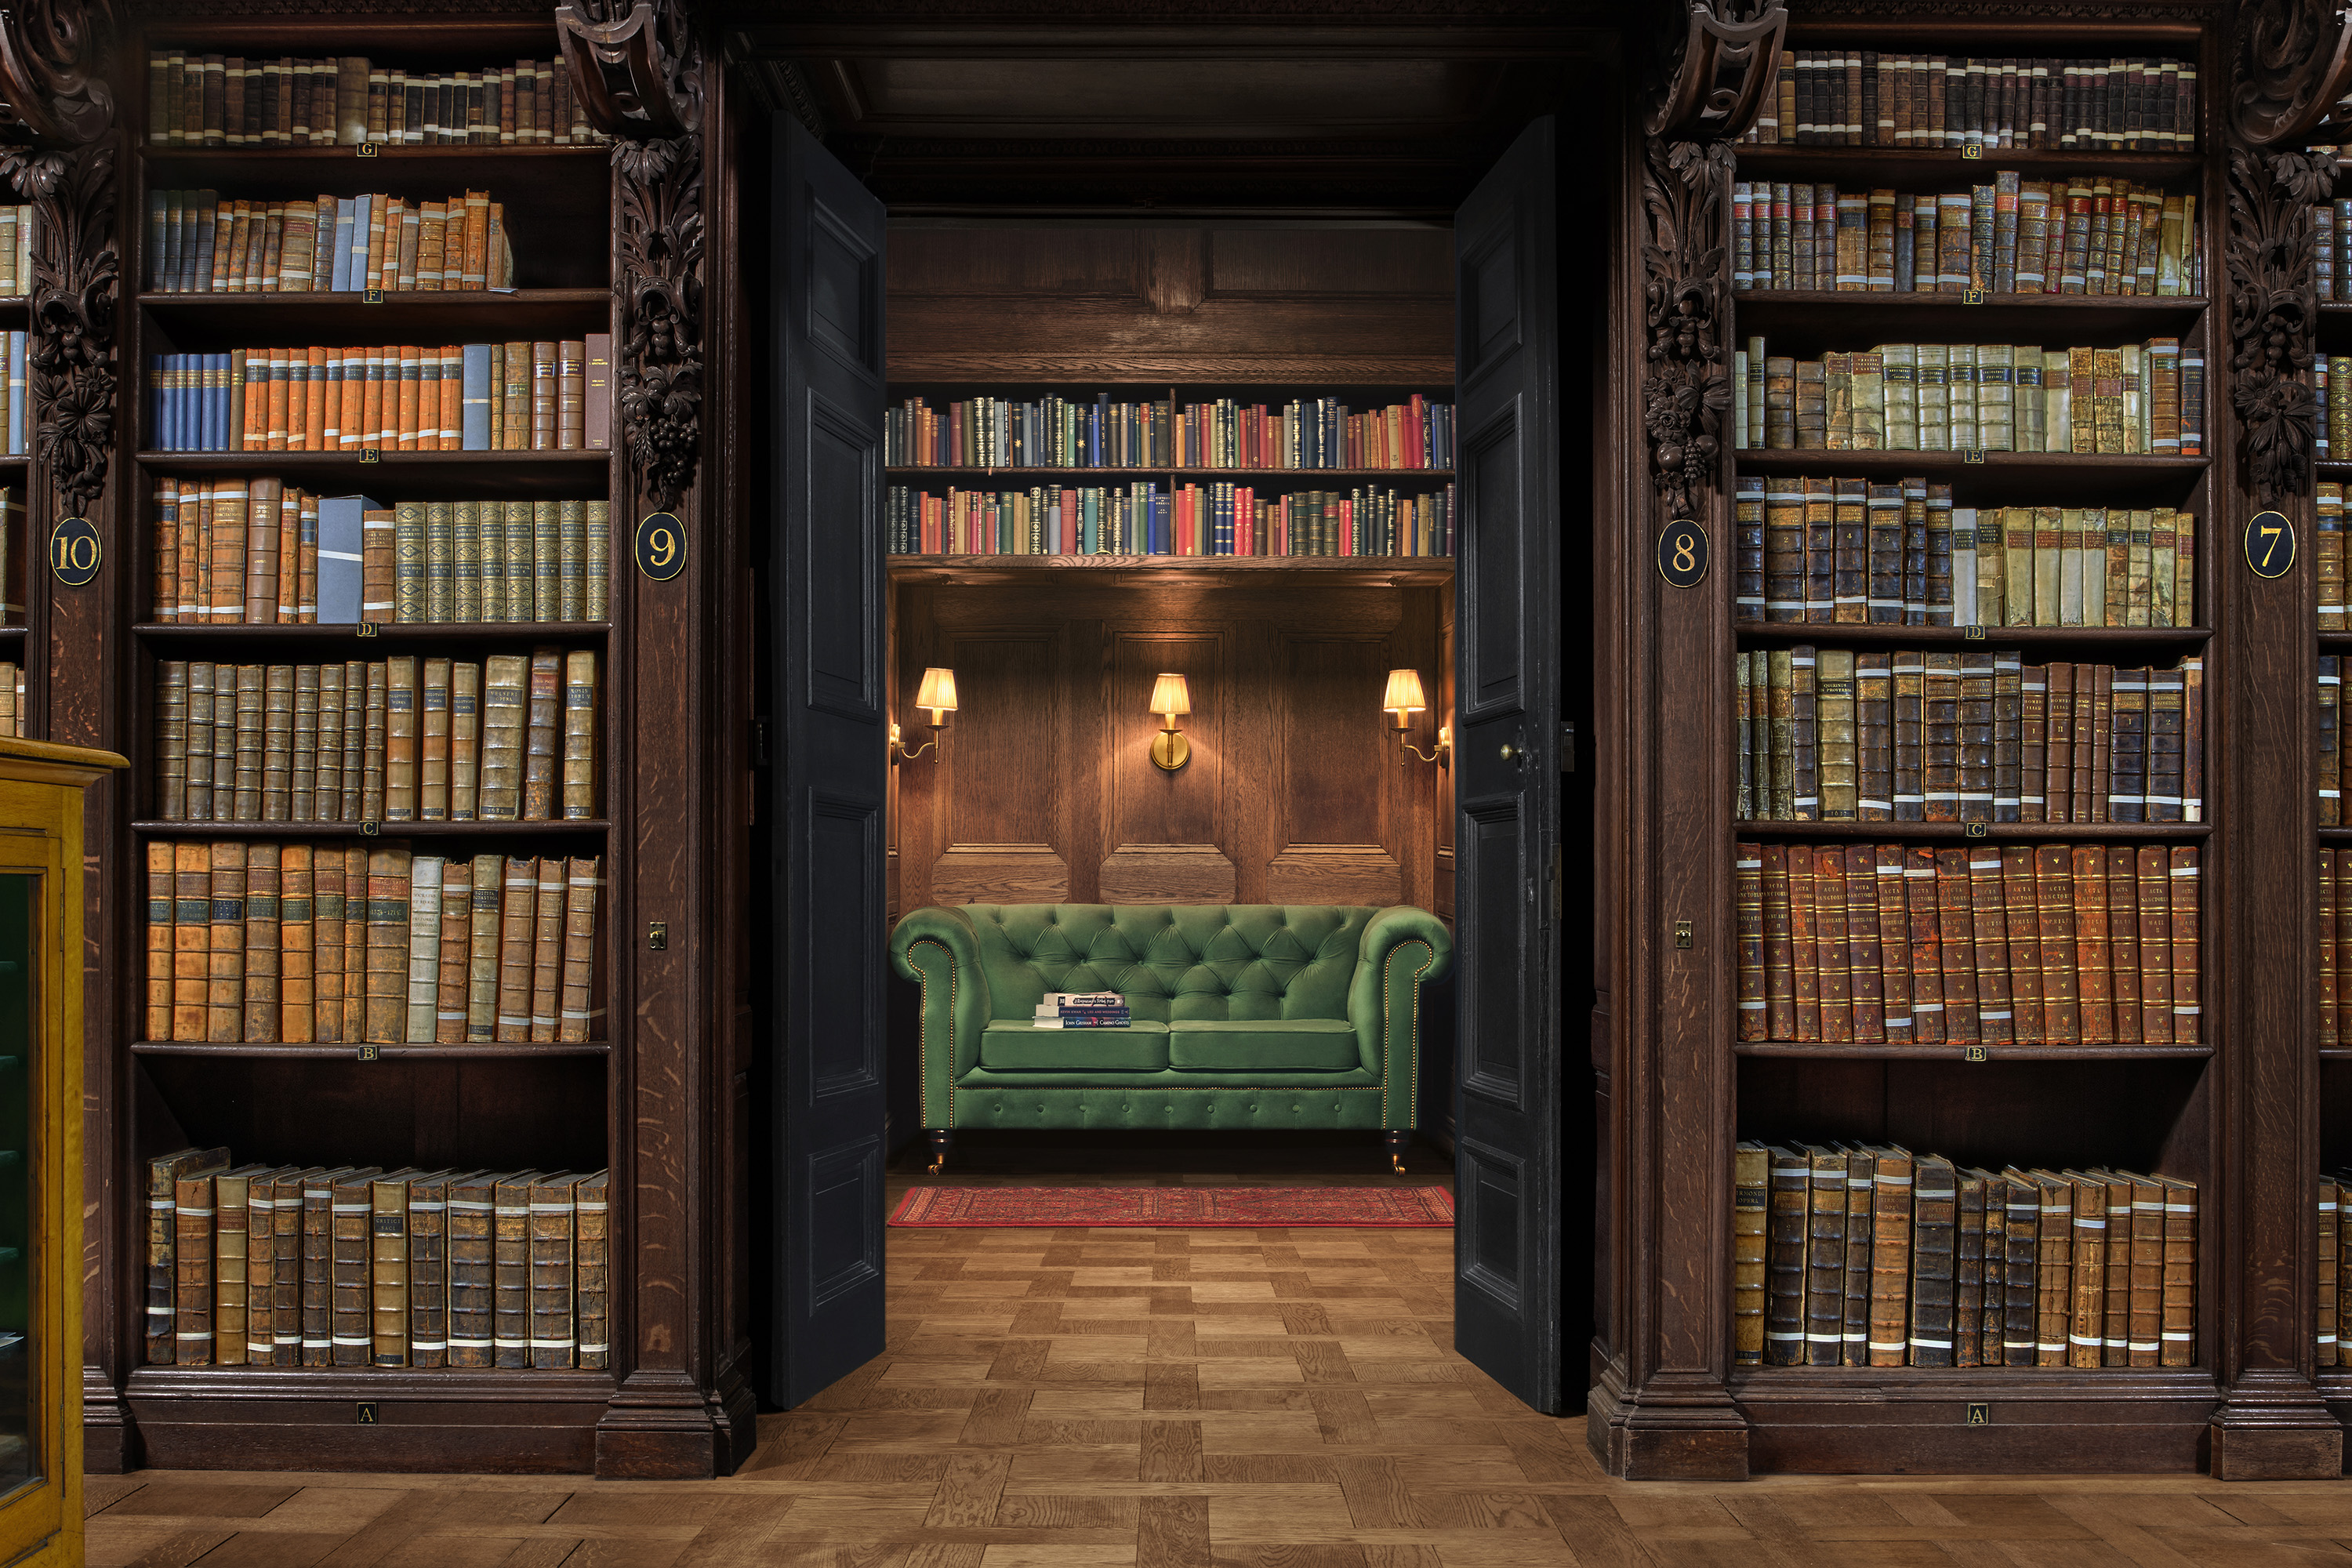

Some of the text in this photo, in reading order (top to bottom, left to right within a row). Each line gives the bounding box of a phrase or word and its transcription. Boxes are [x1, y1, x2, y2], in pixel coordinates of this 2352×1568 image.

[362, 143, 372, 154] G
[1966, 146, 1977, 157] G
[368, 290, 378, 300] F
[1968, 291, 1978, 302] F
[365, 450, 375, 460] E
[1969, 450, 1980, 461] E
[649, 528, 675, 566] 9
[2260, 525, 2282, 567] 7
[56, 536, 97, 569] 10
[1672, 534, 1695, 572] 8
[361, 623, 372, 635] D
[1969, 626, 1981, 637] D
[363, 822, 373, 834] C
[1972, 824, 1981, 835] C
[363, 1047, 374, 1059] B
[1971, 1048, 1983, 1059] B
[360, 1407, 373, 1421] A
[1970, 1408, 1985, 1423] A
